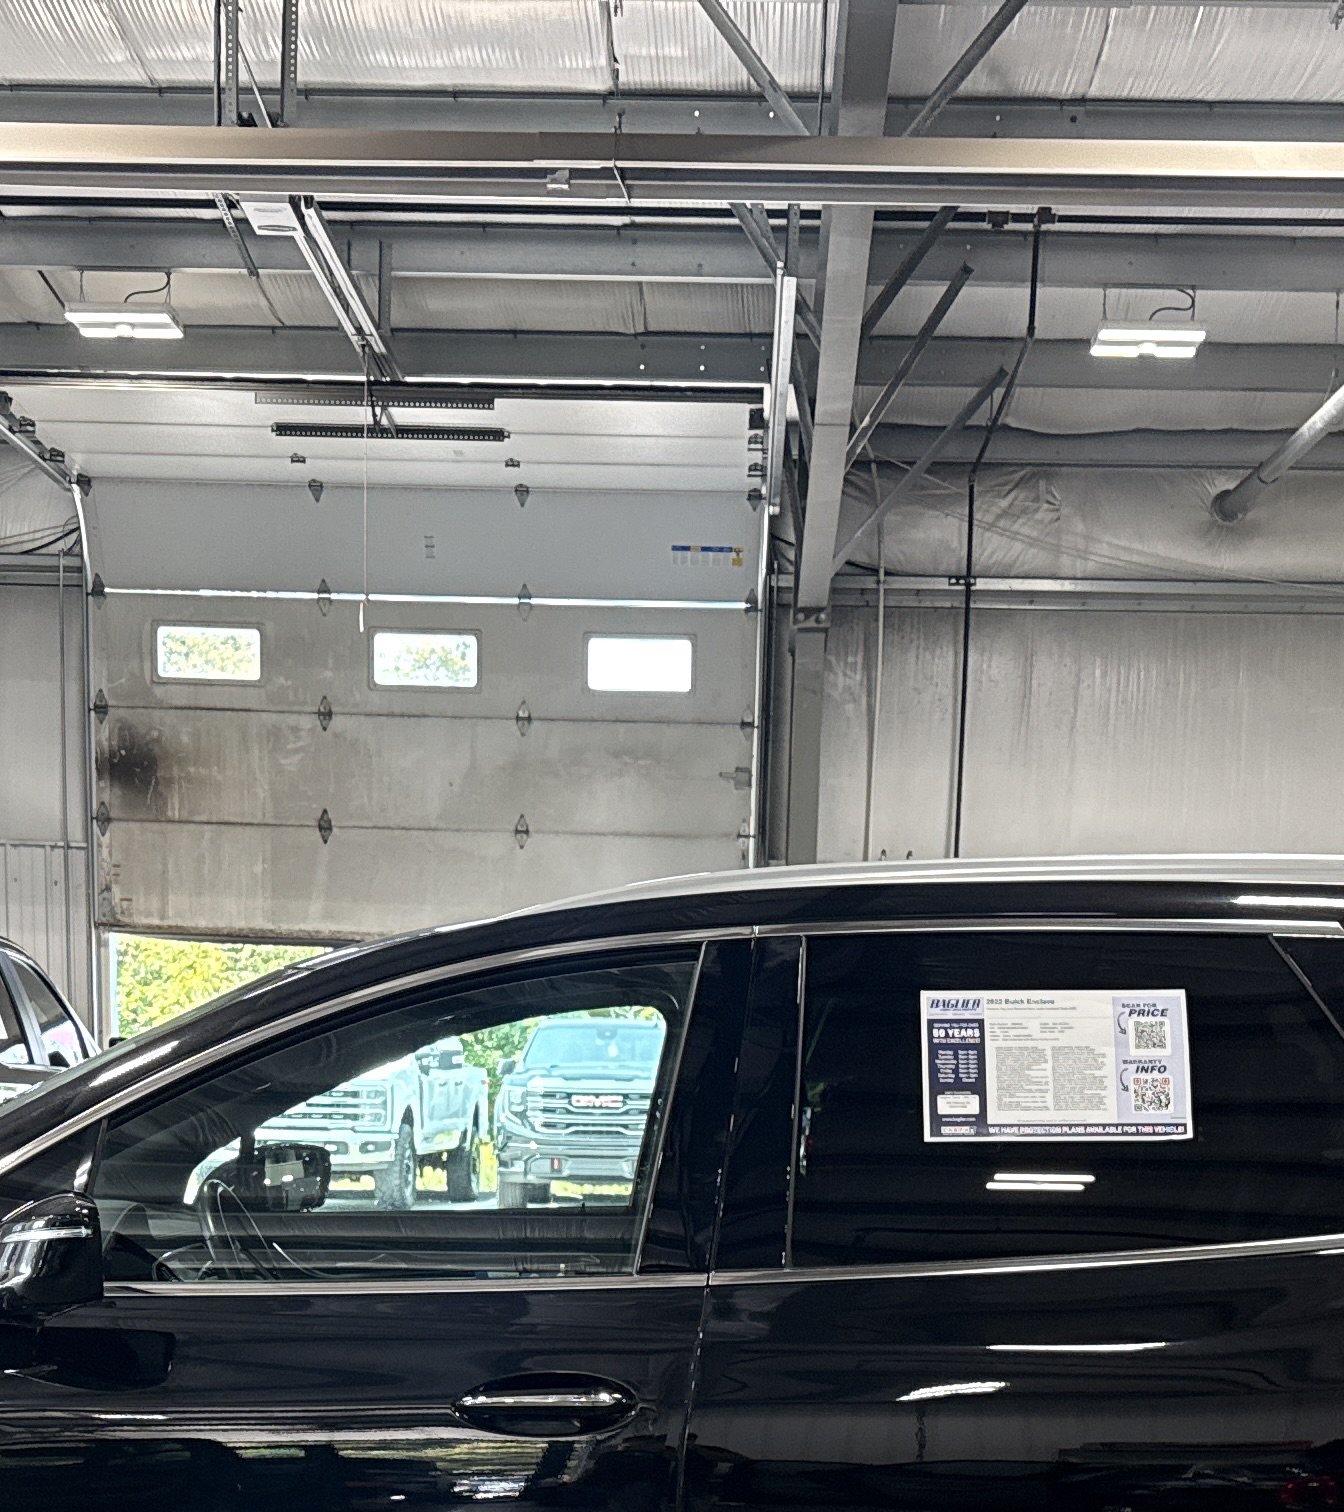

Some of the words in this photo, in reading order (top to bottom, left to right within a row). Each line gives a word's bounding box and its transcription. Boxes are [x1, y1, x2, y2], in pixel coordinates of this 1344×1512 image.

[1128, 1008, 1169, 1018] PRICE
[947, 1028, 980, 1037] YEARS
[1135, 1064, 1167, 1075] INFO
[571, 1094, 624, 1108] GMC
